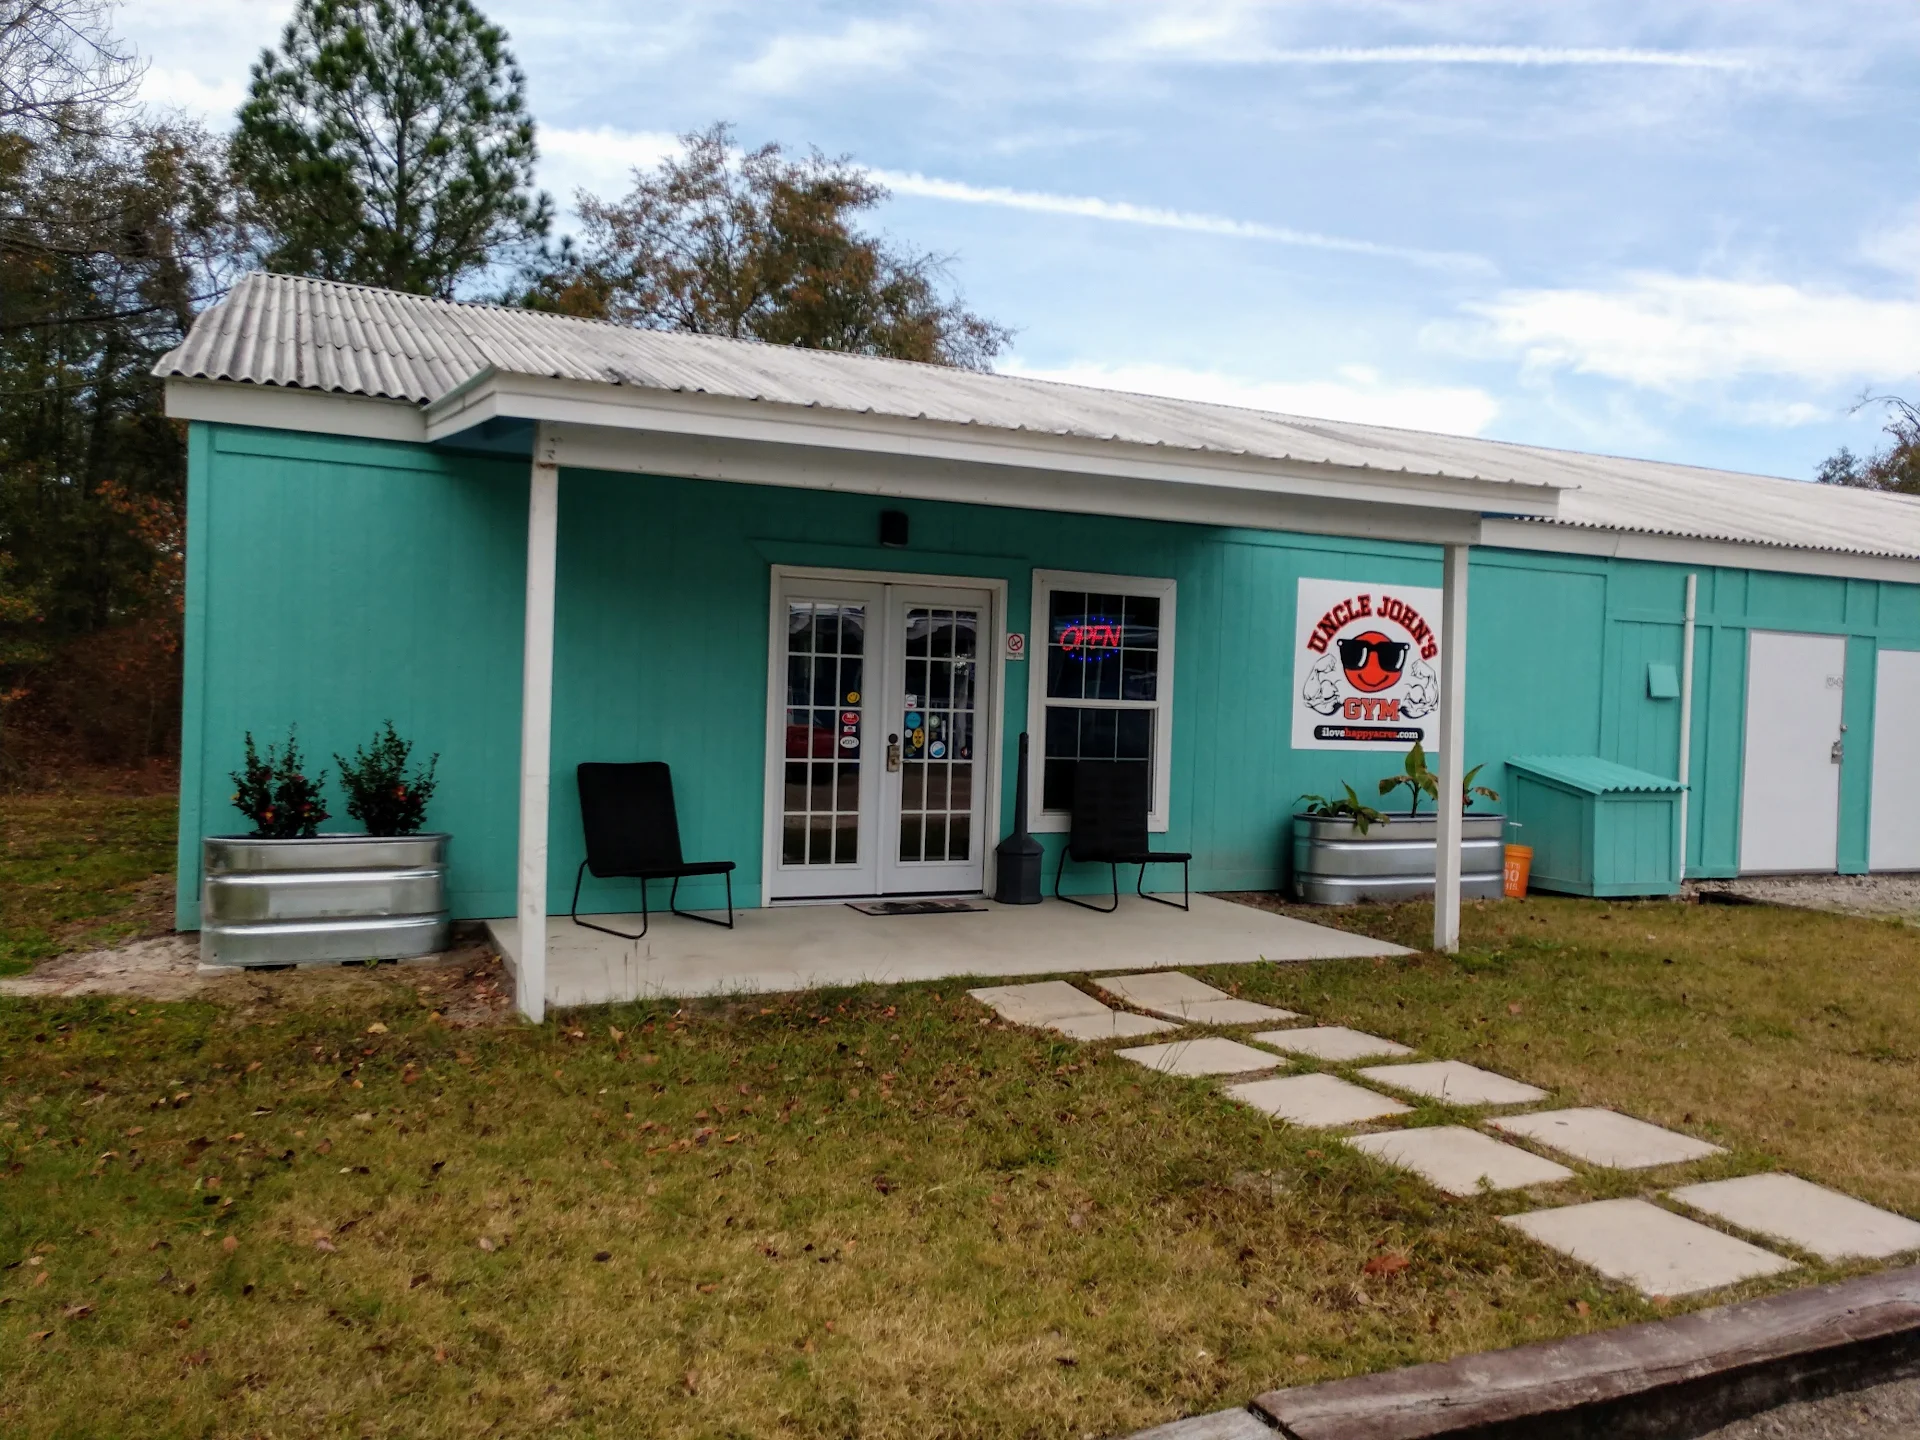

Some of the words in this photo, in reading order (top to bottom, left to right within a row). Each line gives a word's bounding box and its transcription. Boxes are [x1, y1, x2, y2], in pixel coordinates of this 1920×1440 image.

[1059, 624, 1122, 651] OPEN
[1307, 594, 1372, 654] UNCLE
[1377, 596, 1438, 660] JOHN'S
[1343, 697, 1400, 722] GYM
[1321, 727, 1419, 741] ilovehappyacres.com
